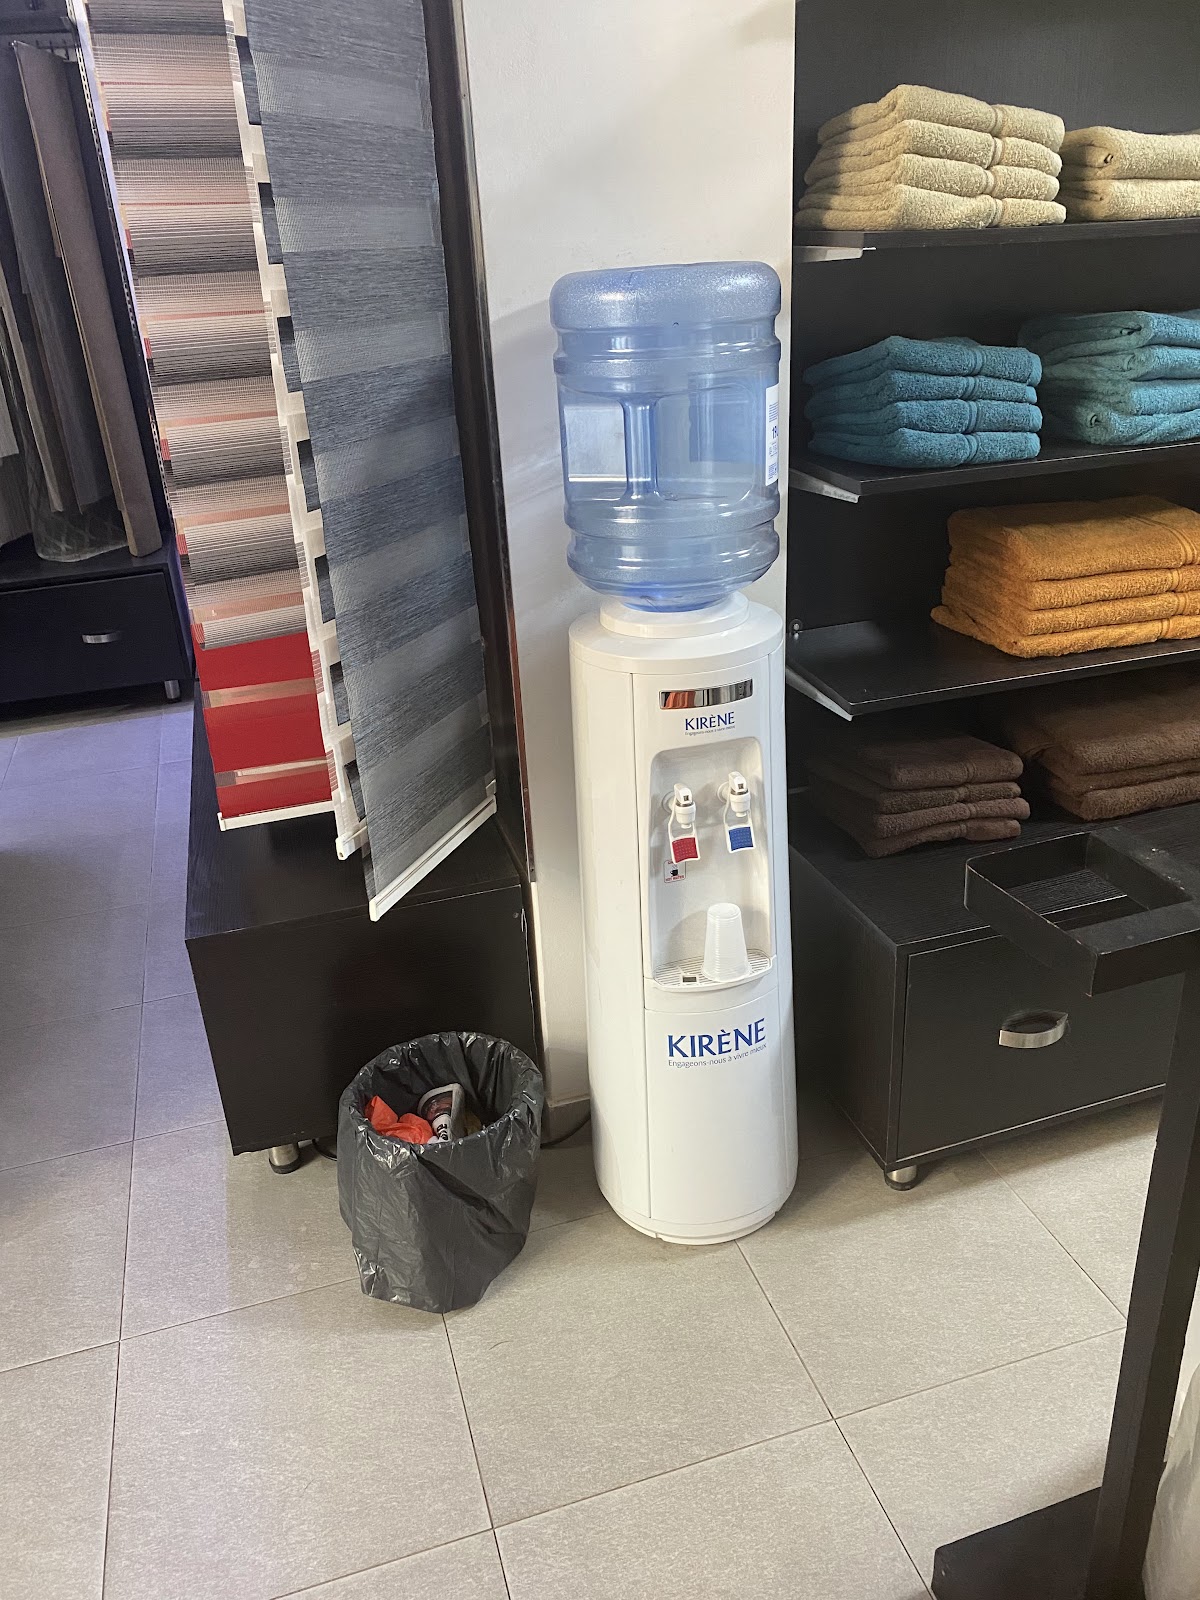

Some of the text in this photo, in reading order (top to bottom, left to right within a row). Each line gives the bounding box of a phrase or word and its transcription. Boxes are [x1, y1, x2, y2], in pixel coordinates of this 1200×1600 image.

[685, 711, 736, 730] KIRÈNE
[667, 1017, 766, 1058] KIRÈNE
[668, 1057, 727, 1069] Engageons-nous
[733, 1051, 749, 1061] vivre
[750, 1043, 767, 1056] mieux
